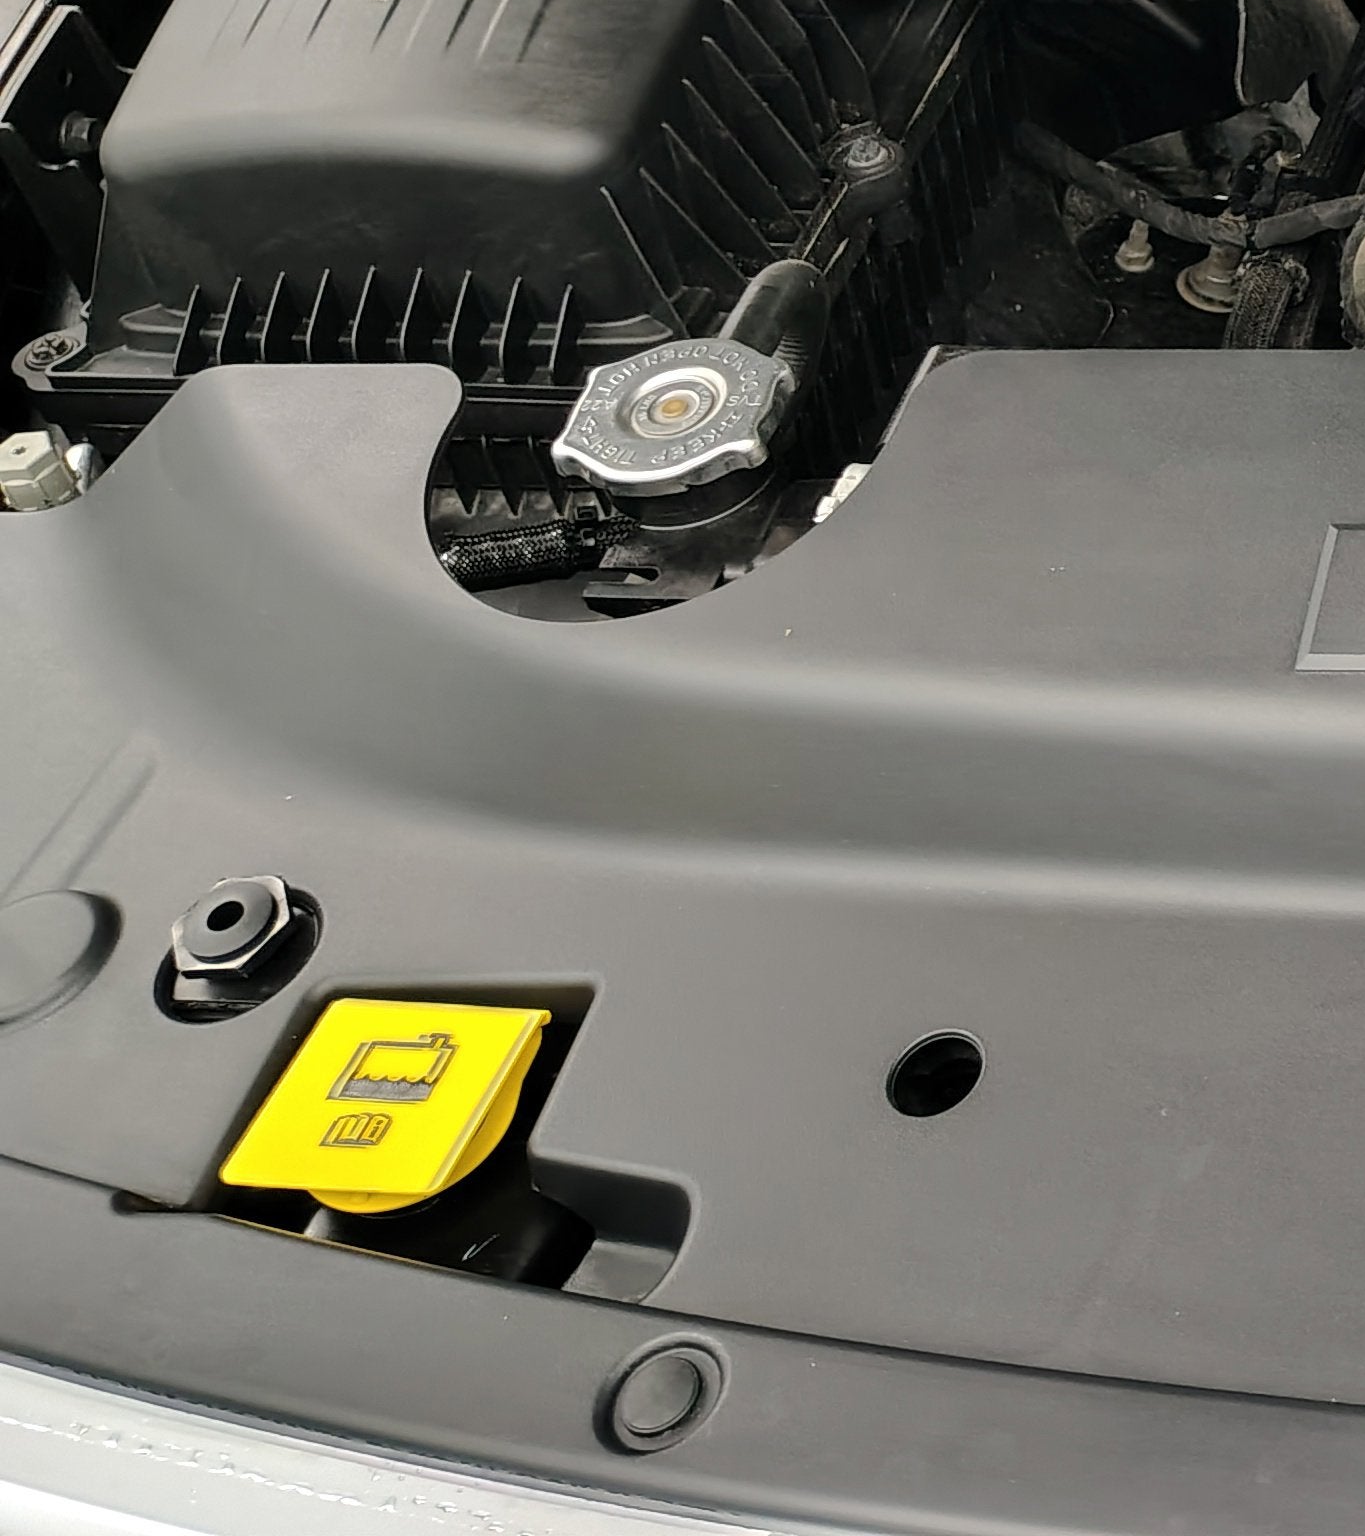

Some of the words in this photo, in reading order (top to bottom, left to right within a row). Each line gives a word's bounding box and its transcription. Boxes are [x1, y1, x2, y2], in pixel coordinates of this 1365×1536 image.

[643, 344, 709, 368] OPEN
[708, 348, 750, 372] NOT
[598, 362, 641, 394] HOT
[582, 434, 639, 466] TIGHT
[650, 428, 720, 465] KEEP
